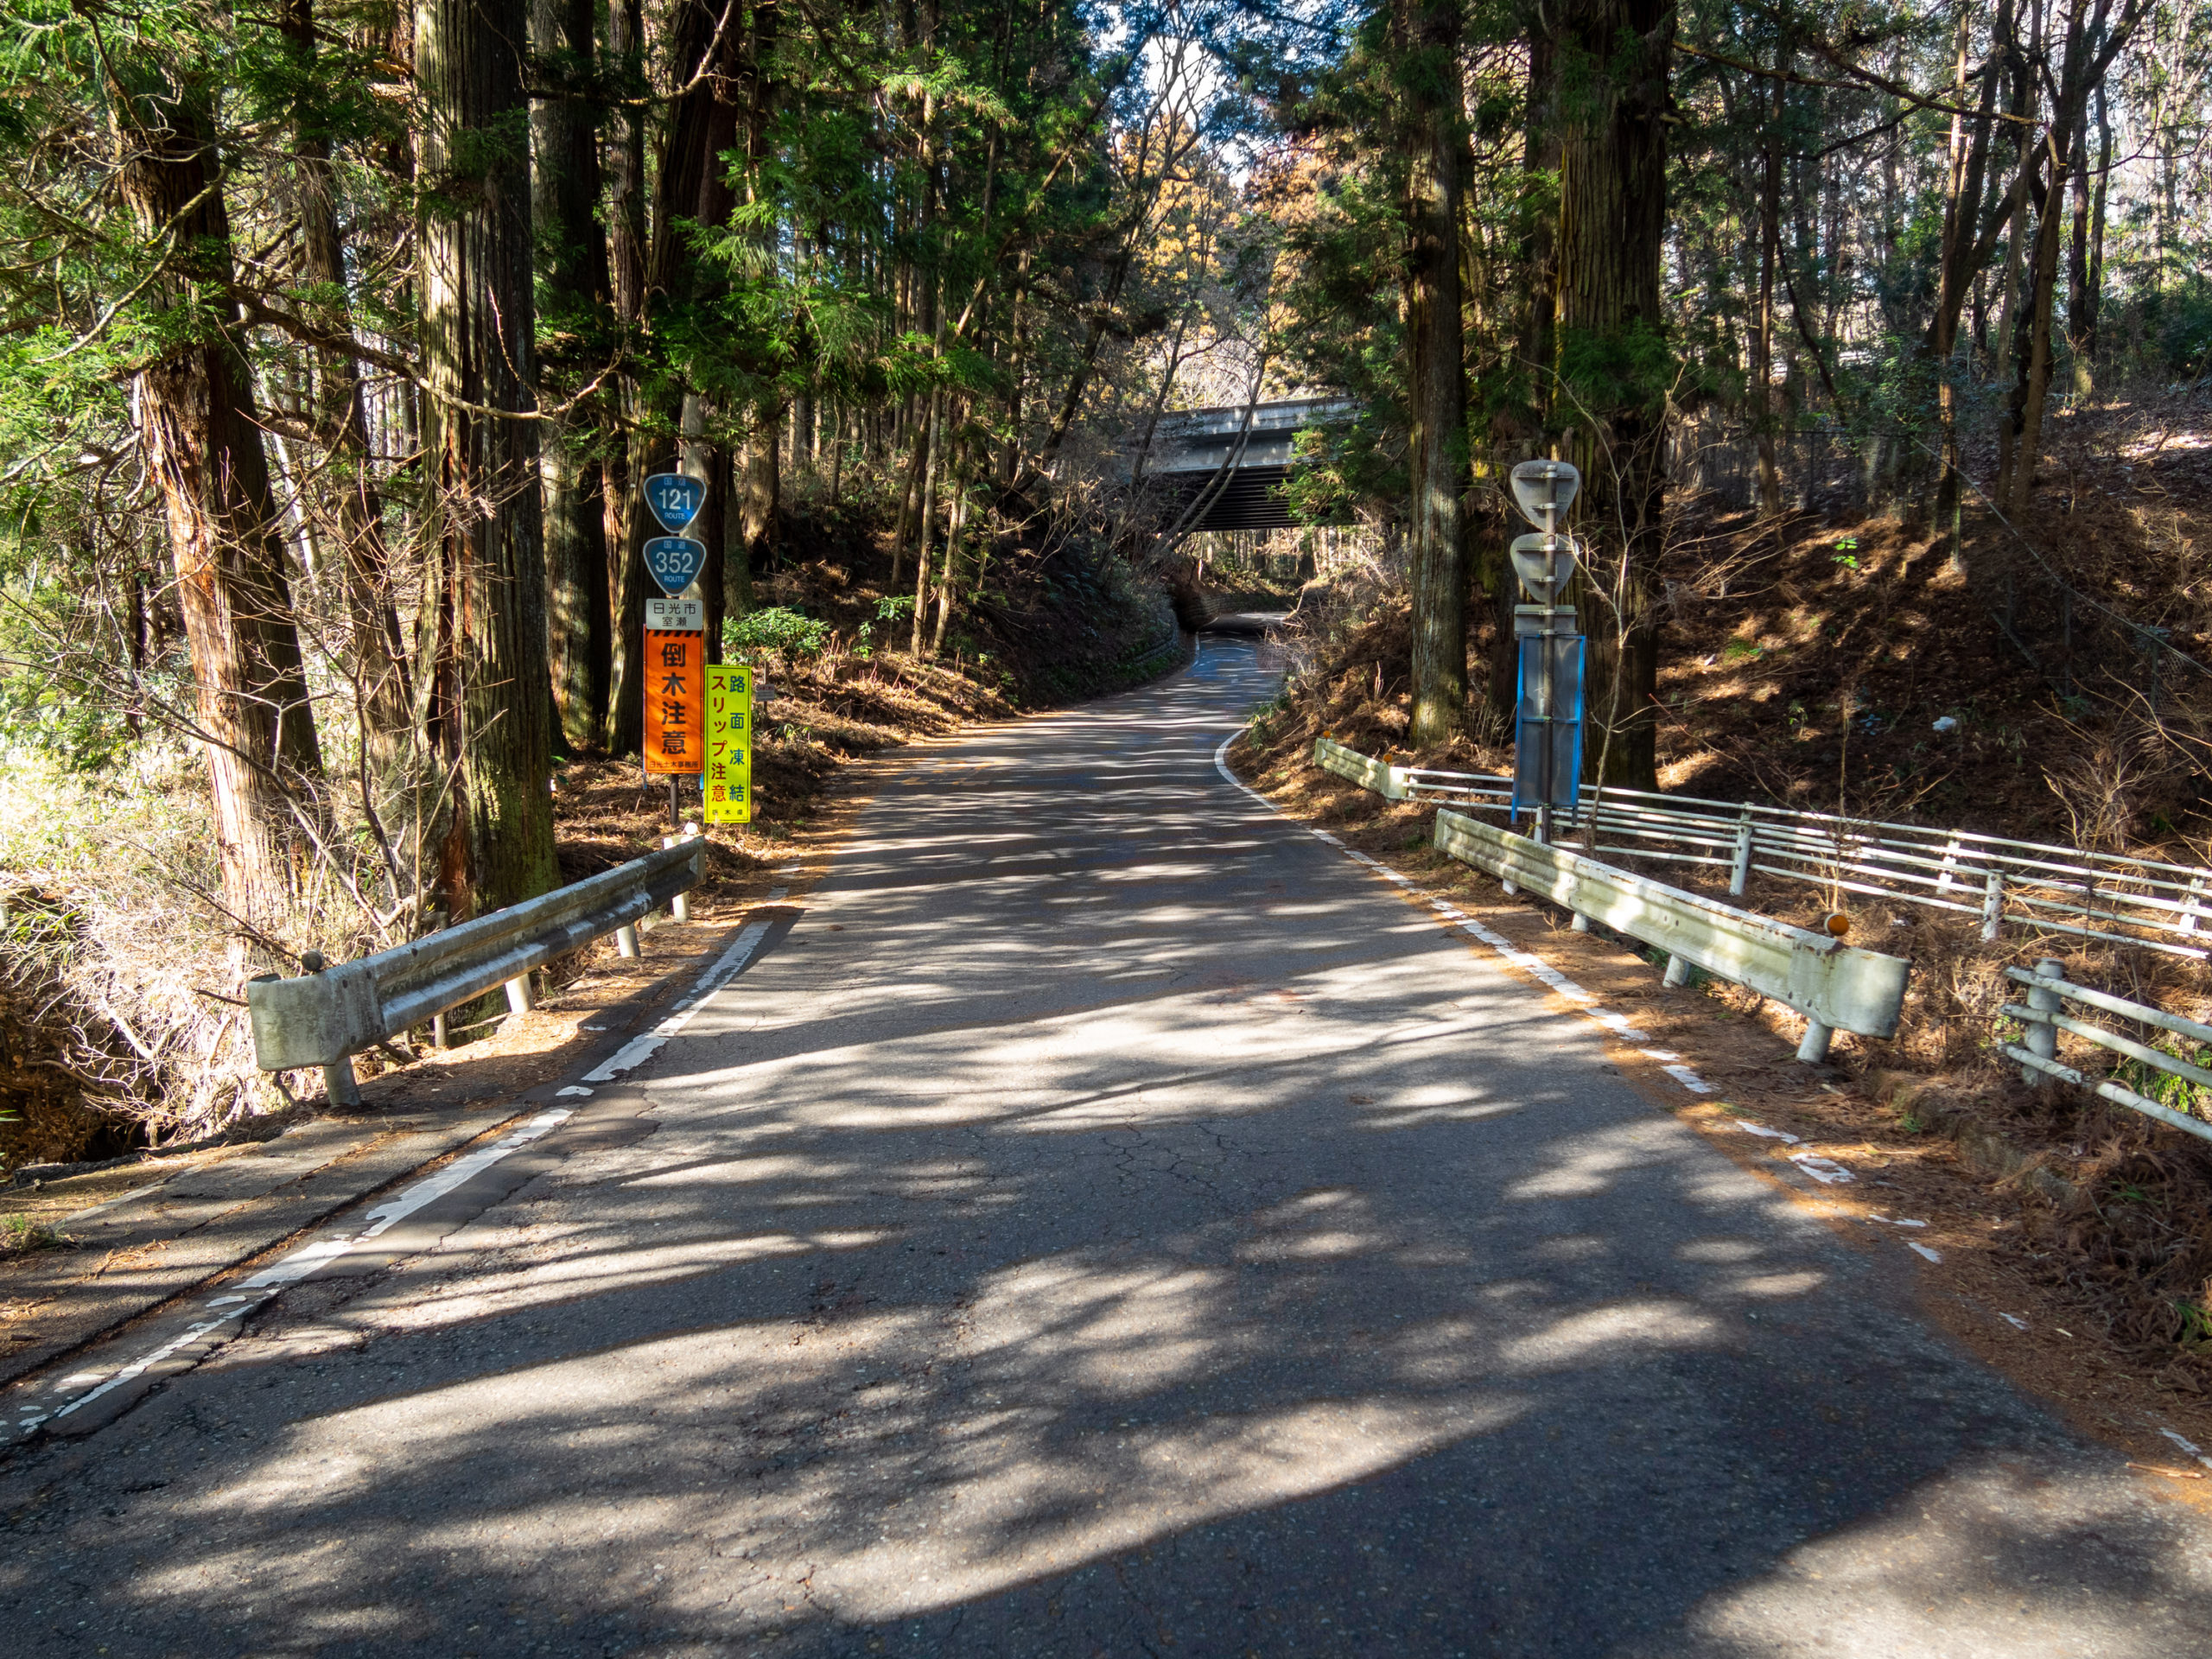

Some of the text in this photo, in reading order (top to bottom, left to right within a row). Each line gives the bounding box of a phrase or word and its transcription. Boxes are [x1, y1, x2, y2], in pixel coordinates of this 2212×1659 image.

[659, 488, 690, 510] 121
[656, 552, 693, 573] 352
[654, 603, 696, 614] 日光市
[662, 616, 687, 626] 室瀬
[661, 643, 687, 754] 倒木注意
[711, 676, 728, 802] スリップ注意
[729, 675, 746, 802] 路面凍結
